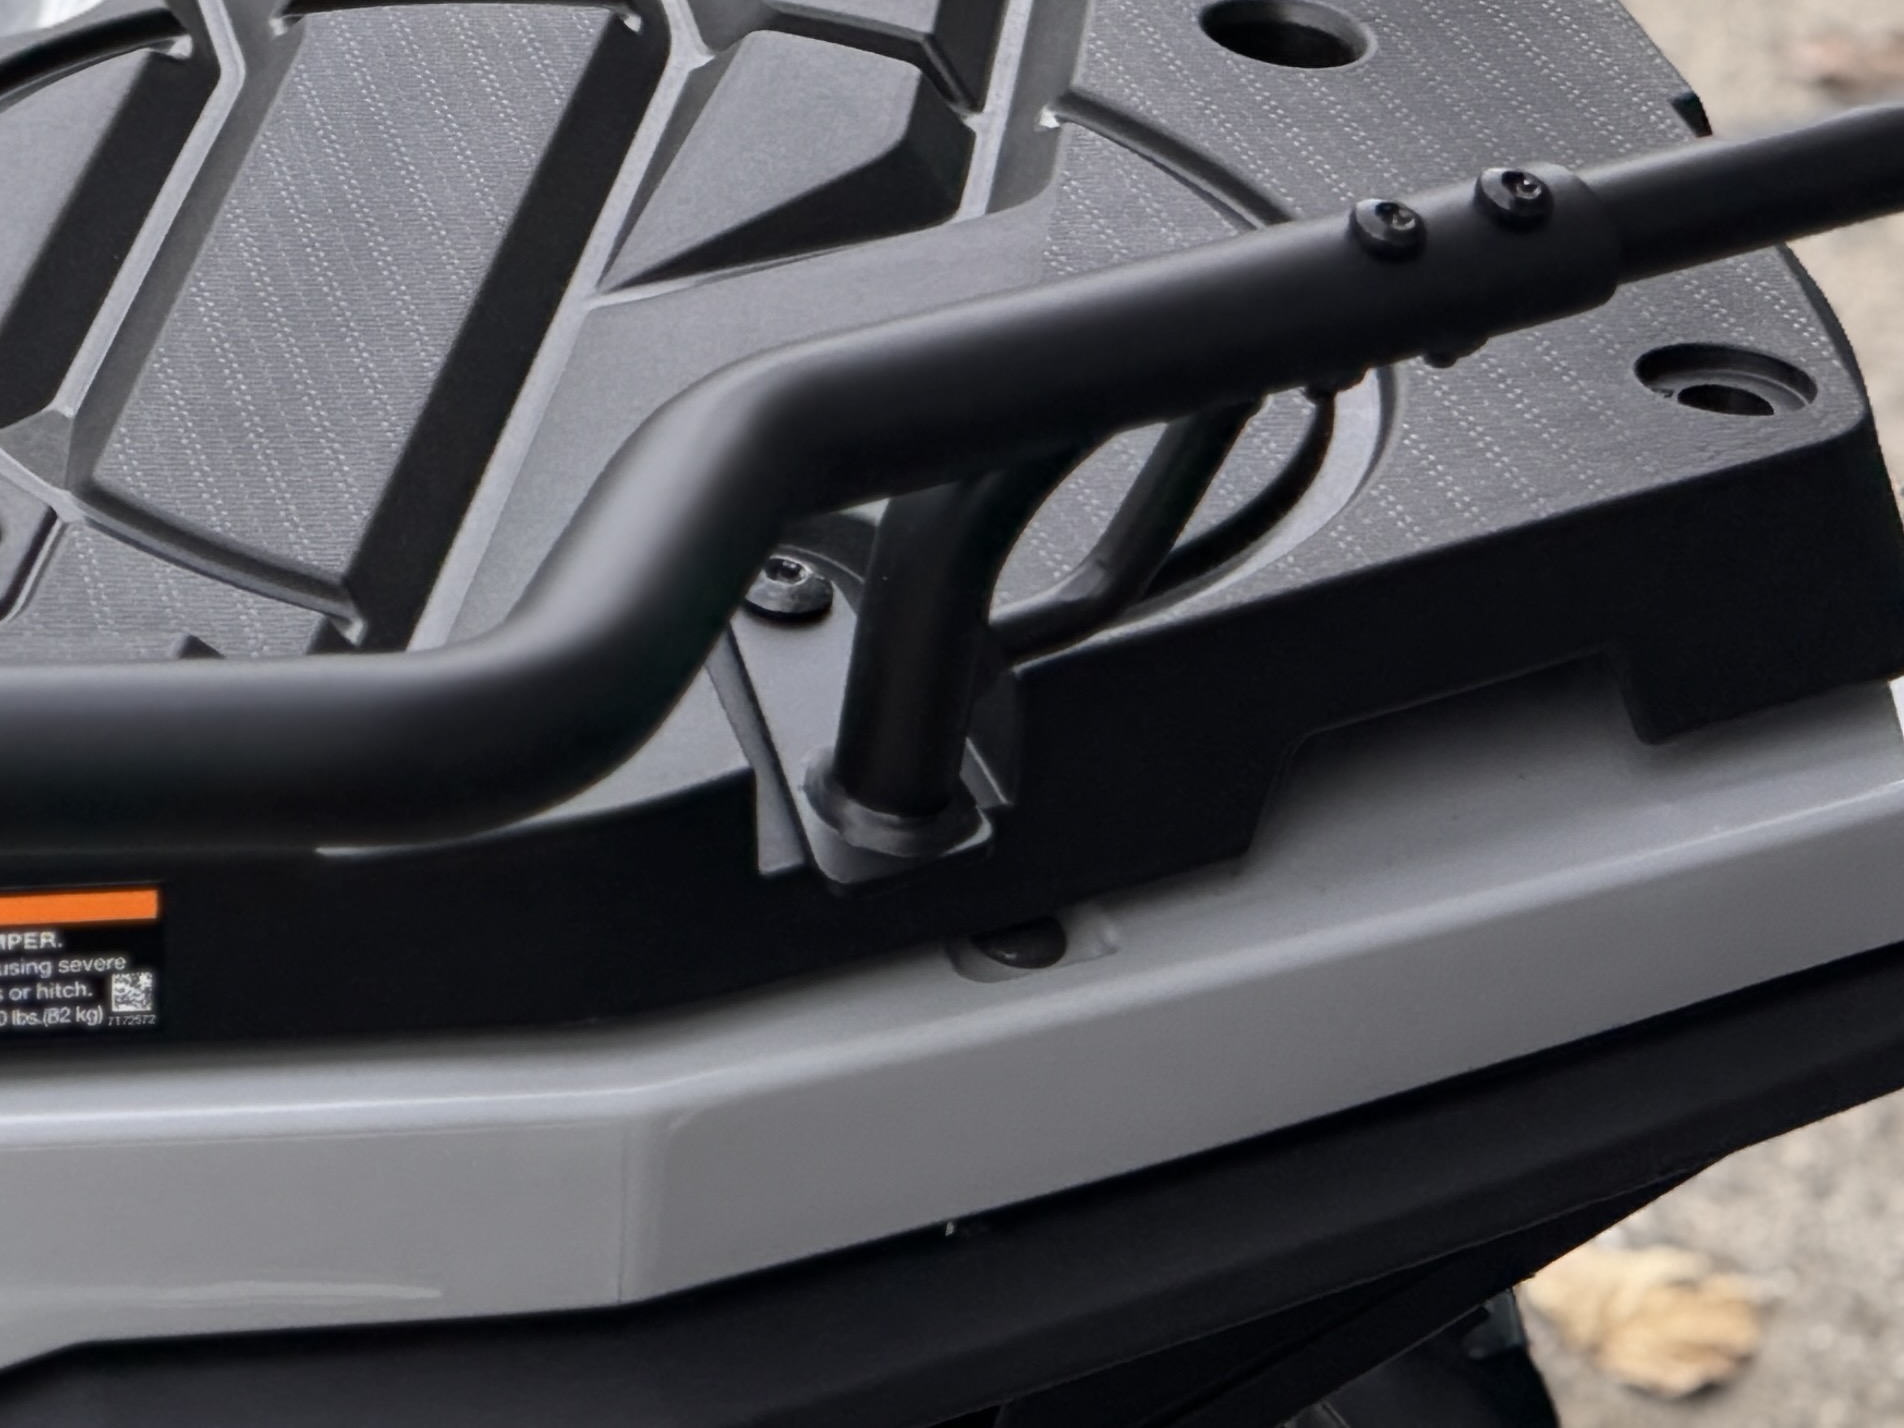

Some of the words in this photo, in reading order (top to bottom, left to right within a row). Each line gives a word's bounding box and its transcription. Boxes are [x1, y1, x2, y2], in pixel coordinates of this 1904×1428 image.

[58, 956, 126, 973] severe
[8, 987, 30, 1001] or
[36, 981, 93, 999] hitch.
[76, 1005, 103, 1026] kg)
